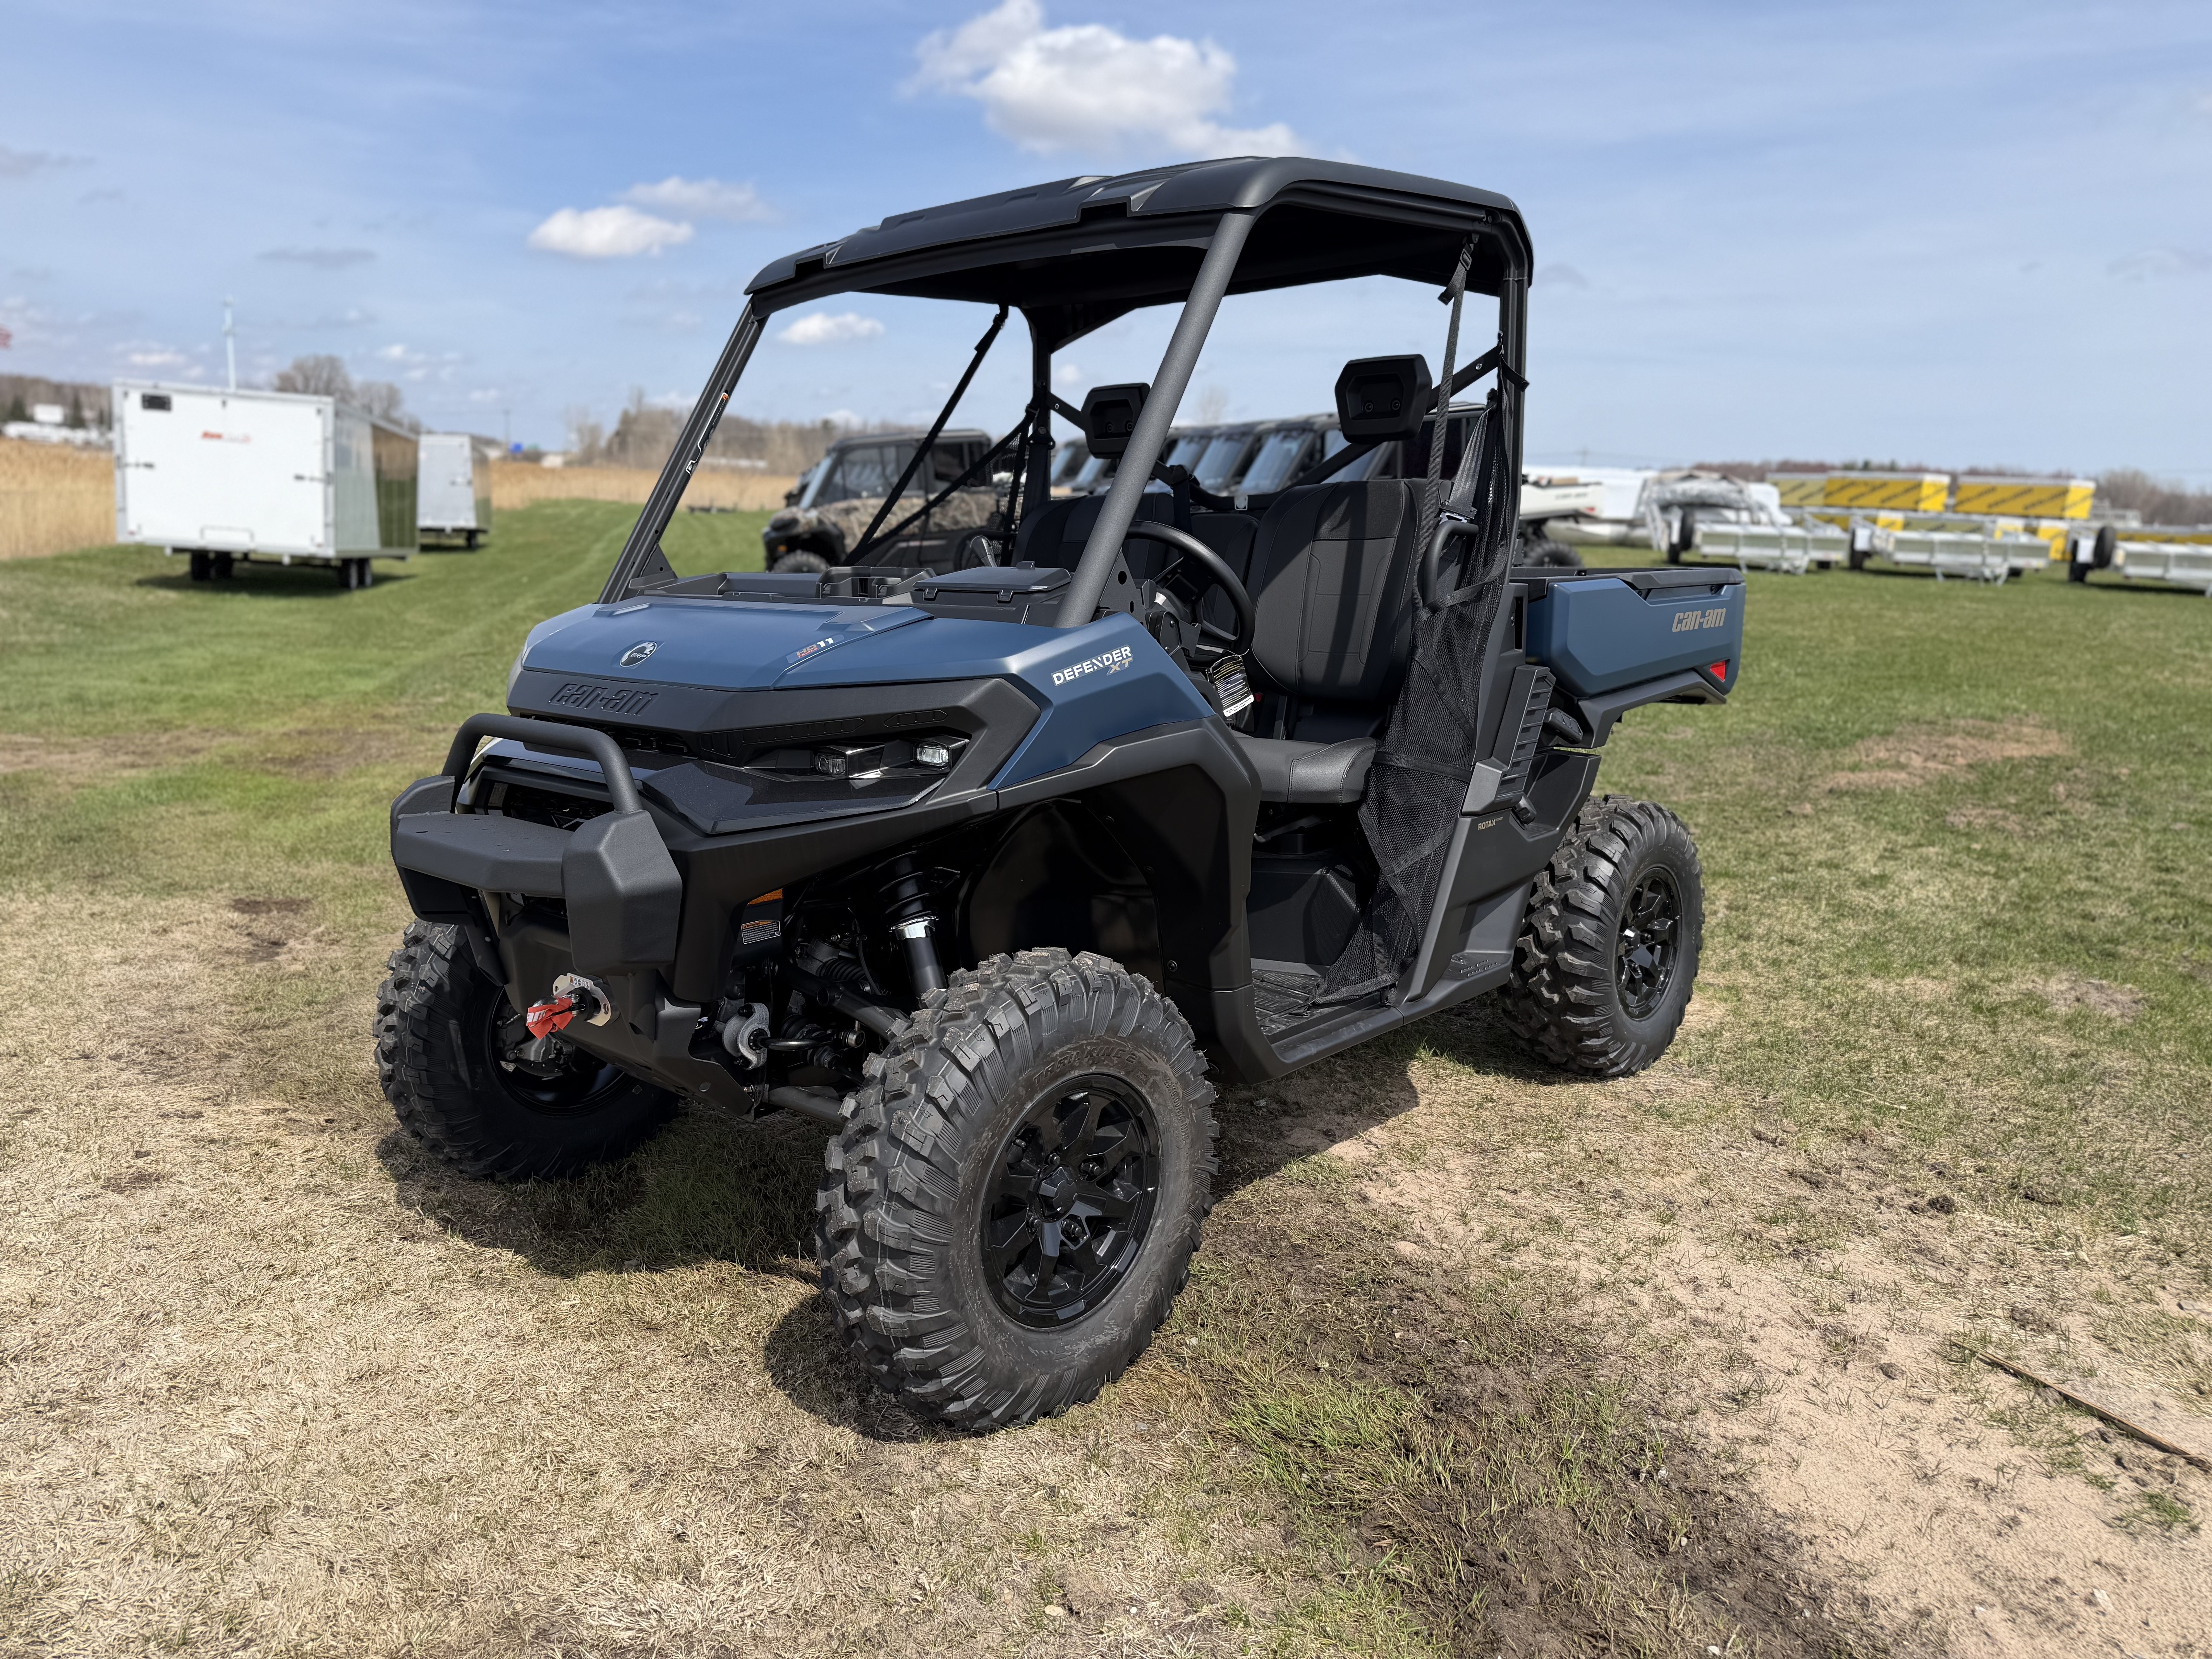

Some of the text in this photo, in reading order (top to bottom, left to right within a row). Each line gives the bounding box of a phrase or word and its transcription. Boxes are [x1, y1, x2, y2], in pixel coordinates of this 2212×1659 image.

[1672, 608, 1726, 632] can-am
[1053, 646, 1132, 685] DEFENDER
[1109, 657, 1132, 674] XT
[548, 683, 659, 716] can-am
[1478, 819, 1496, 831] ROTAX
